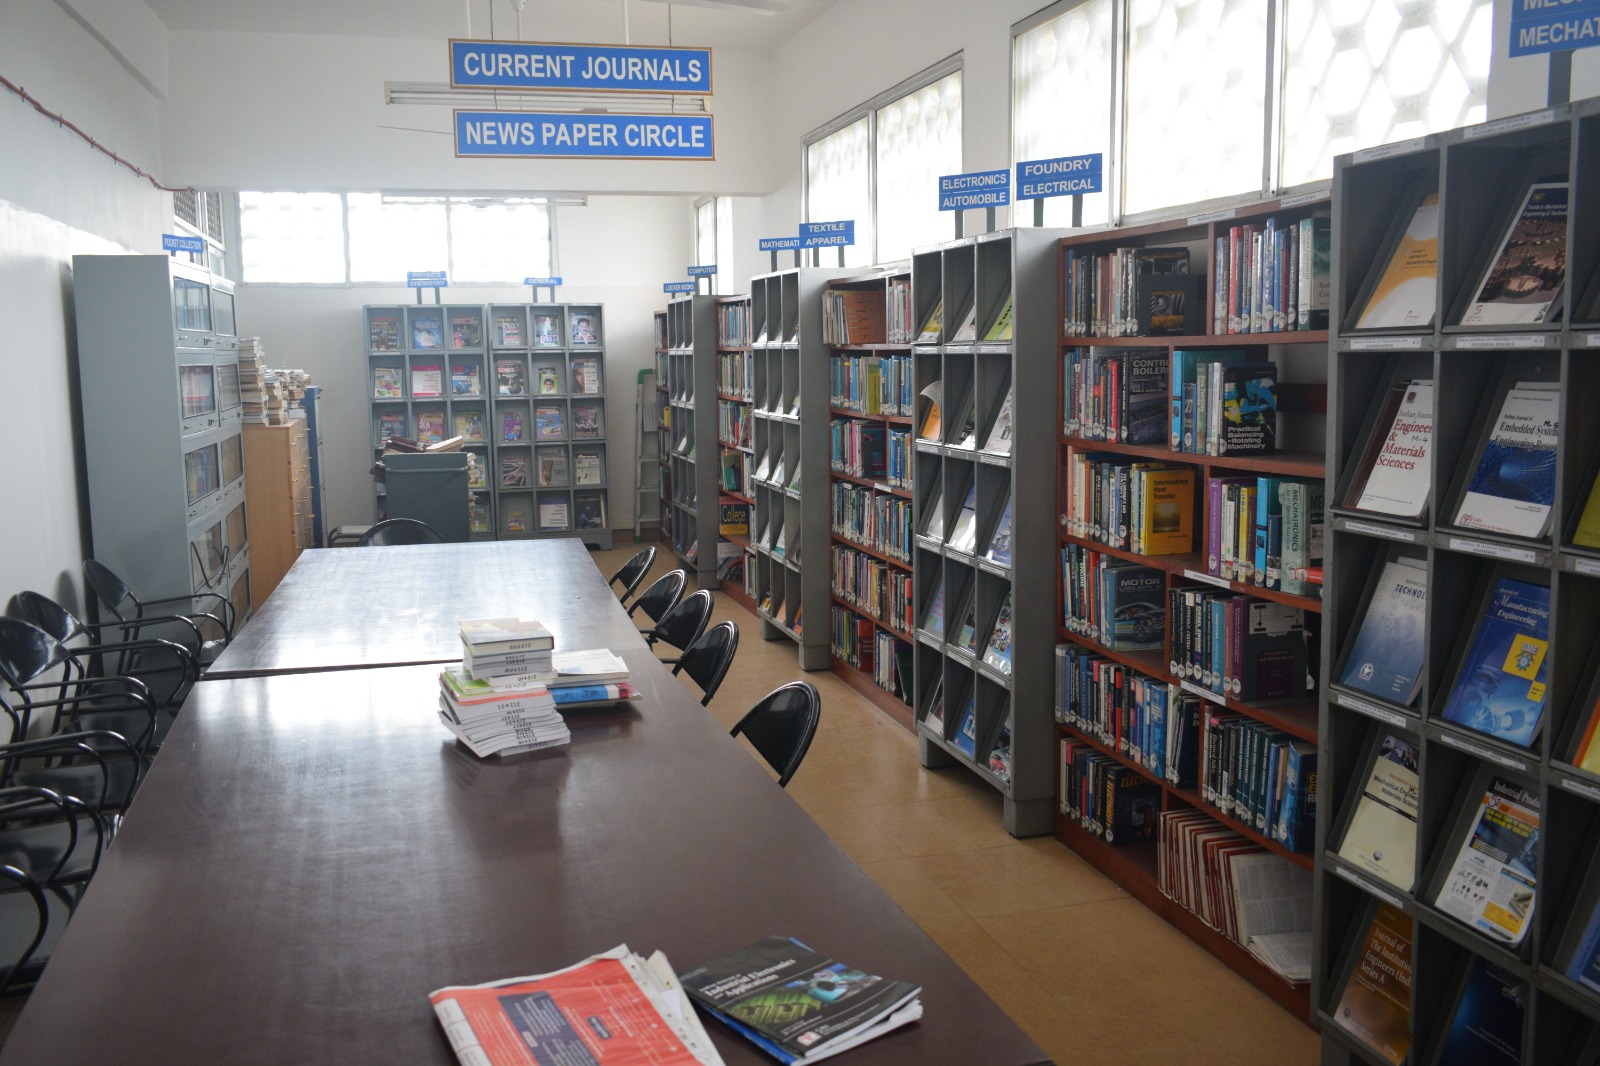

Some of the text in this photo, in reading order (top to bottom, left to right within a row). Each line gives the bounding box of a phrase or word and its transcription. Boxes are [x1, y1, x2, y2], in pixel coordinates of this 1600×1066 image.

[464, 52, 702, 82] CURRENT JOURNALS
[465, 121, 705, 148] NEWS PAPER CIRCLE
[1025, 158, 1093, 177] FOUNDRY
[942, 173, 1007, 190] ELECTRONICS
[1023, 178, 1095, 196] ELECTRICAL
[942, 192, 1006, 208] AUTOMOBILE
[808, 222, 846, 233] TEXTILE
[164, 237, 202, 250] POCKET COLLECTION
[805, 236, 849, 246] APPAREL
[412, 271, 442, 279] PHYSICS
[688, 266, 716, 275] COMPUTER
[1398, 410, 1416, 418] Indian
[1499, 421, 1535, 434] Embedded
[1388, 431, 1398, 442] &
[1383, 443, 1425, 458] Materials
[1376, 455, 1416, 471] Sciences
[722, 505, 746, 524] College
[1291, 489, 1299, 552] MECHATRONICS
[1119, 584, 1162, 593] VEHICLE
[1120, 578, 1160, 587] MOTOR
[1494, 594, 1549, 619] Manufacturing
[1497, 609, 1538, 627] Engineering
[1521, 643, 1539, 655] SME
[1373, 774, 1400, 791] Mechanical
[1493, 780, 1522, 800] Industrial
[1105, 780, 1114, 829] ELECTRICITY
[1370, 938, 1382, 953] The
[1374, 927, 1406, 953] Journal of
[1365, 949, 1395, 976] Engineers
[704, 959, 797, 997] Industrial Electronics
[1361, 961, 1385, 984] Series A
[724, 974, 780, 998] Applications
